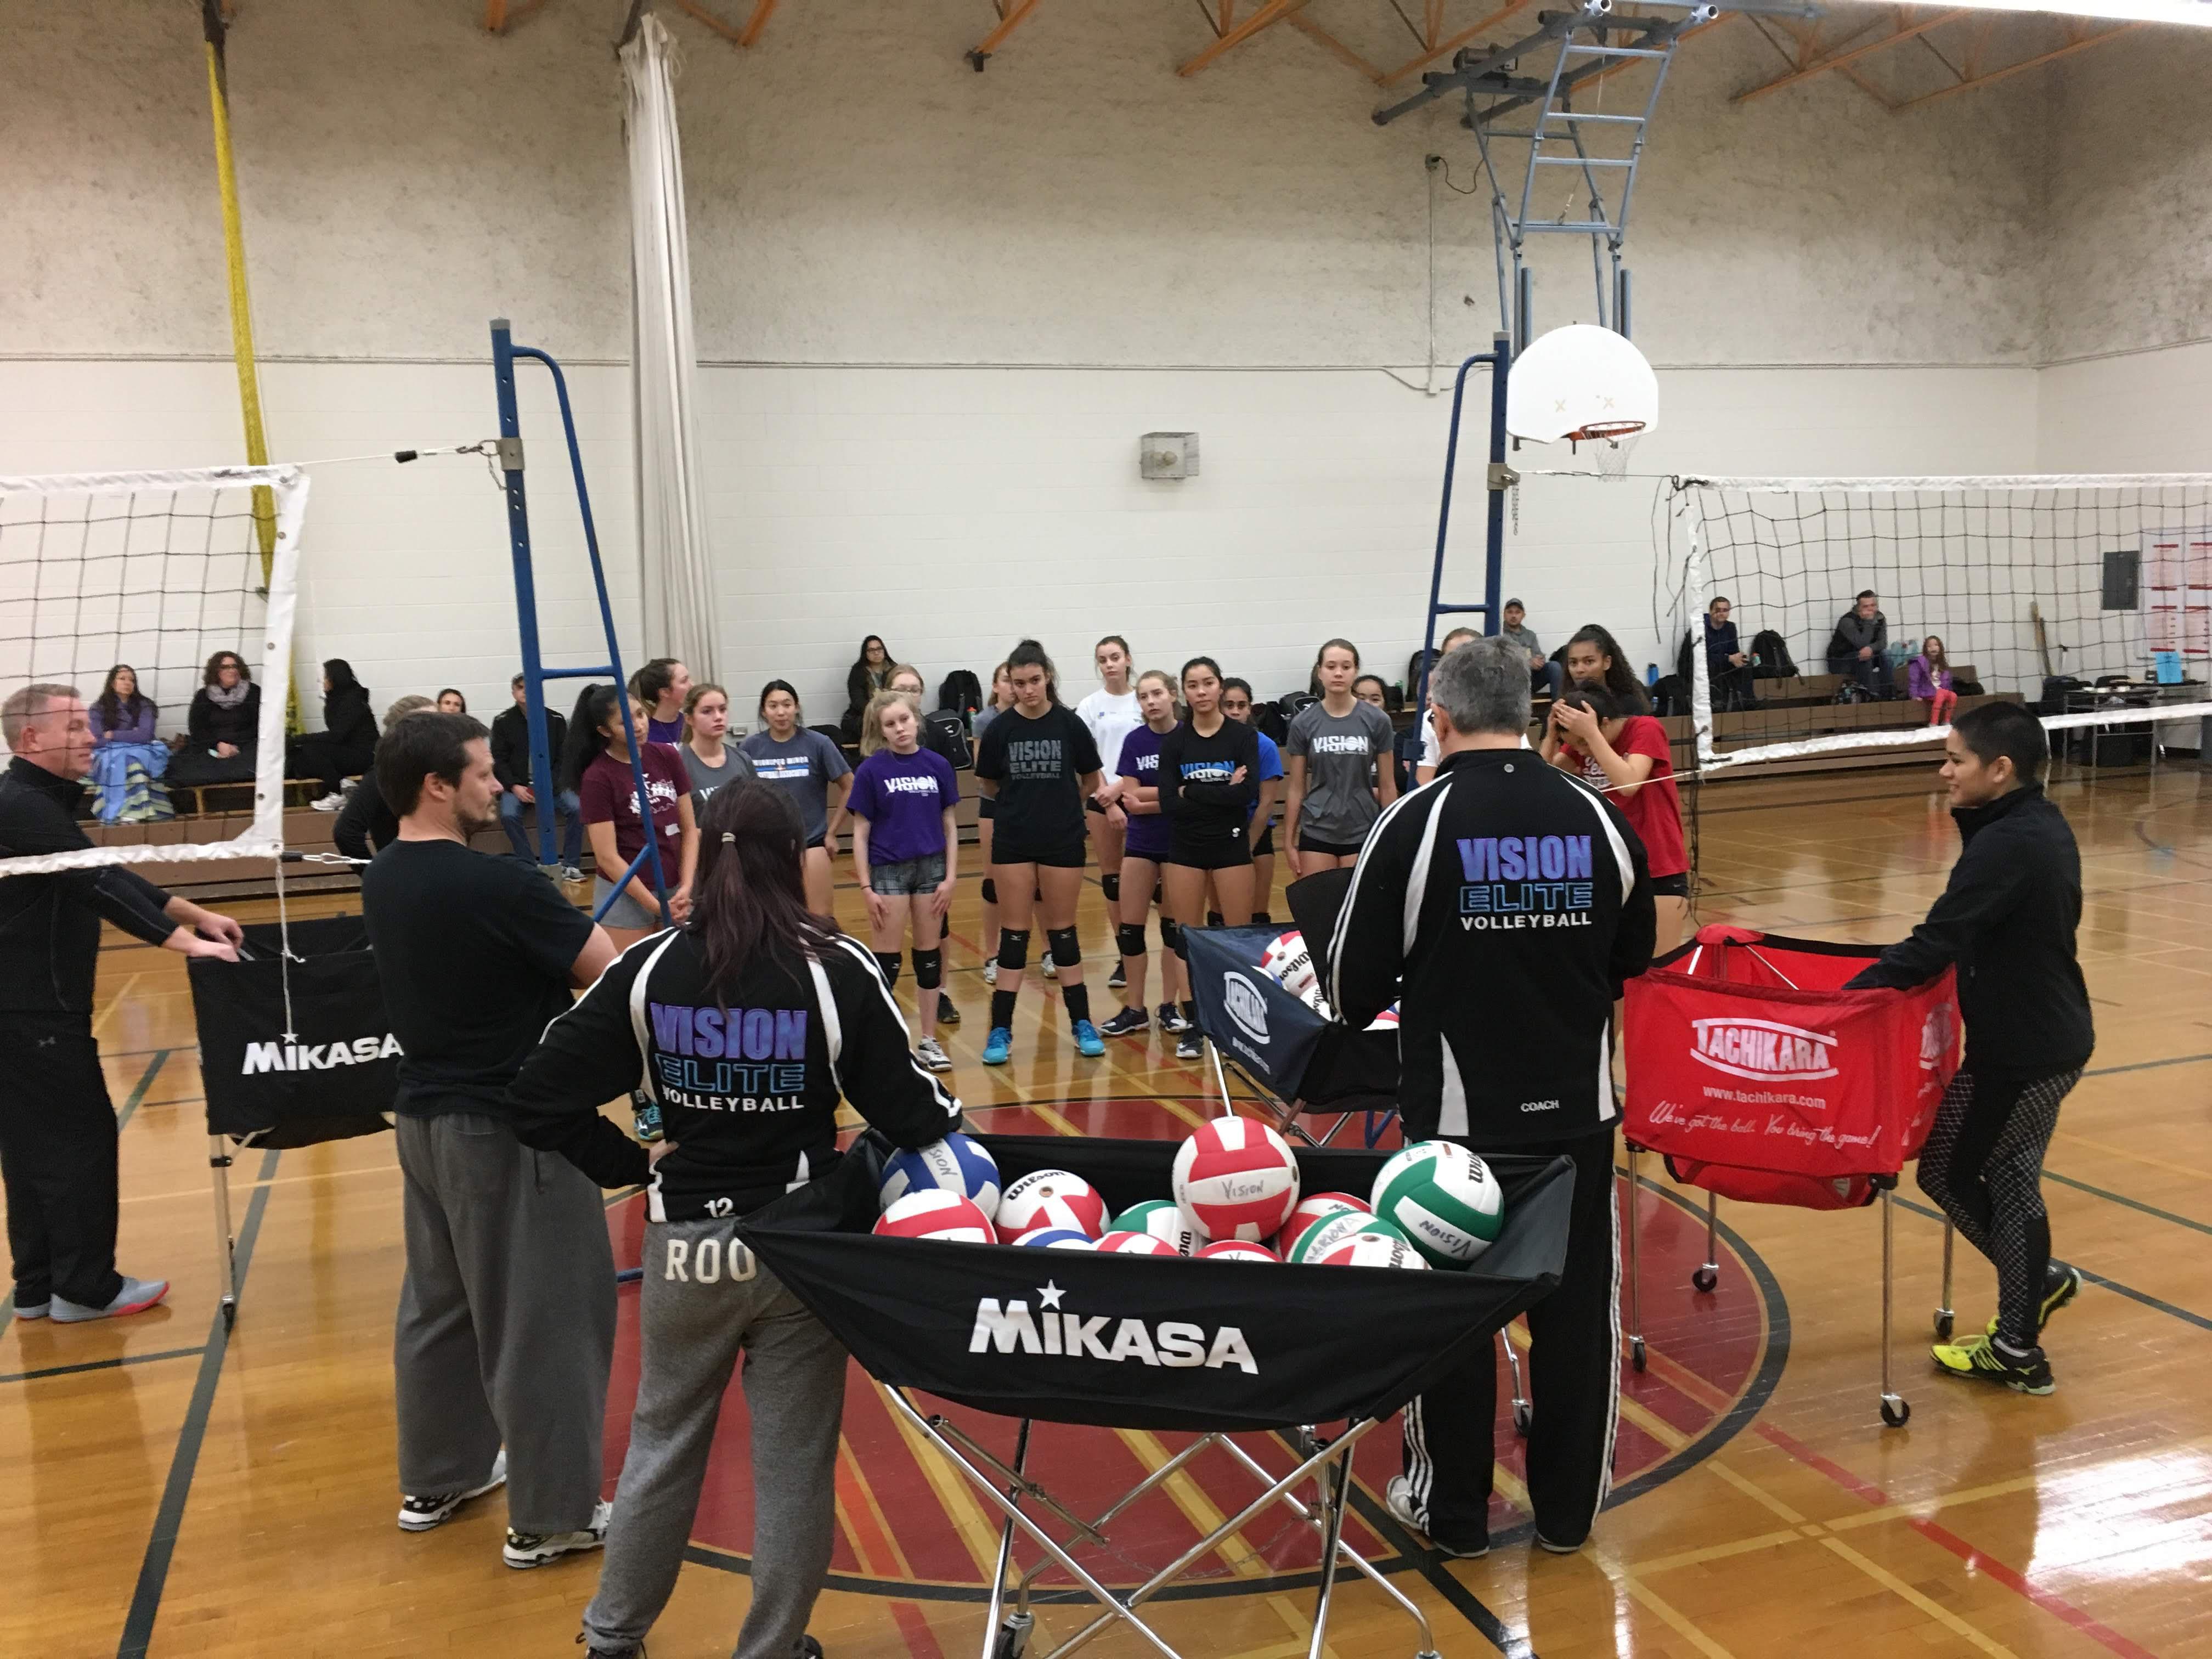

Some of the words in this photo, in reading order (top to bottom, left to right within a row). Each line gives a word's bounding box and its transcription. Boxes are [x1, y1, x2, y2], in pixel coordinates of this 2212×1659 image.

[1008, 740, 1062, 761] VISION
[1313, 736, 1369, 753] VISION
[1009, 760, 1062, 774] ELITE
[1135, 754, 1160, 771] VIS
[1180, 760, 1235, 780] VISION
[884, 775, 939, 793] VISION
[1457, 836, 1593, 882] VISION
[1460, 882, 1593, 913] ELITE
[1460, 912, 1592, 931] VOLLEYBALL
[650, 1002, 808, 1059] VISION
[1691, 1018, 1837, 1075] TACHIKARA
[655, 1053, 805, 1093] ELITE
[662, 1084, 804, 1112] VOLLEYBALL
[1520, 1099, 1560, 1112] COACH
[1703, 1086, 1826, 1109] www.tachikara.com
[1707, 1115, 1728, 1131] the
[1764, 1114, 1784, 1136] You
[1787, 1122, 1817, 1146] bring
[1813, 1126, 1836, 1143] the
[929, 1149, 958, 1176] SION
[1006, 1171, 1066, 1200] Wilson
[704, 1197, 733, 1218] 12
[664, 1238, 758, 1284] ROO
